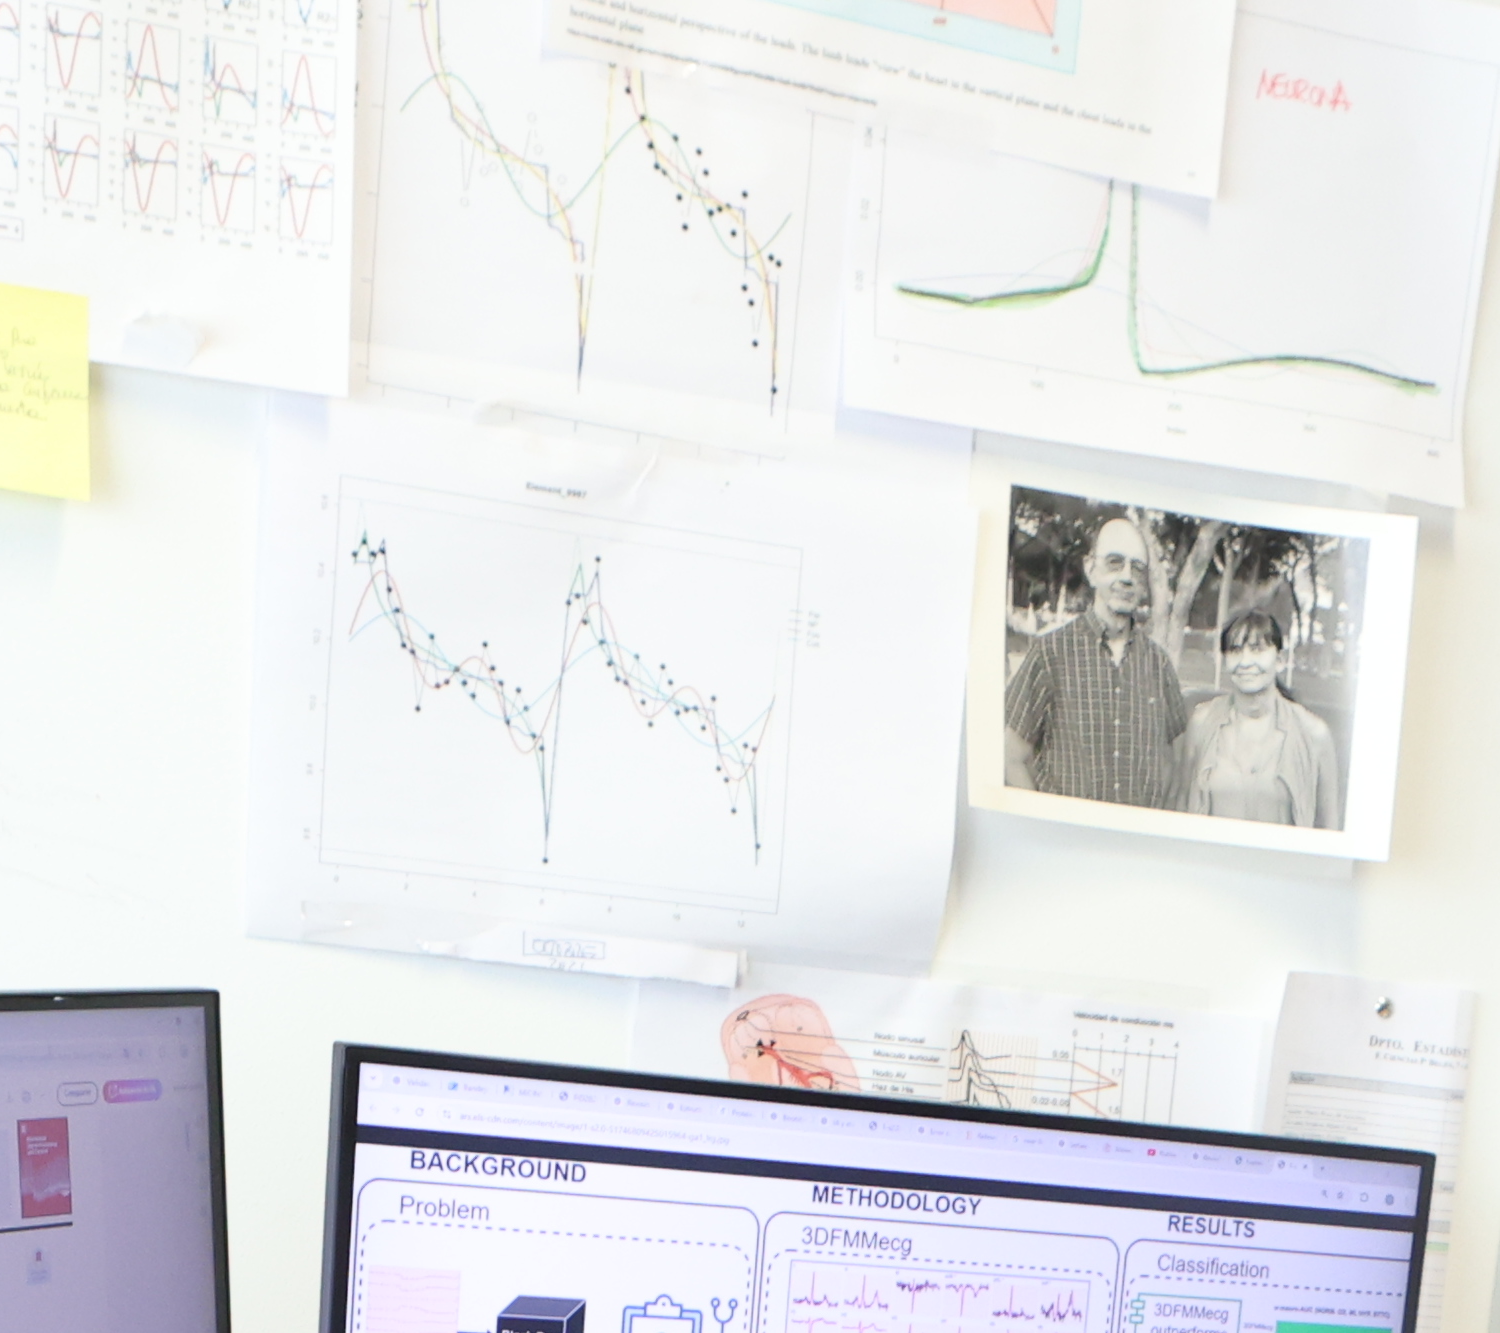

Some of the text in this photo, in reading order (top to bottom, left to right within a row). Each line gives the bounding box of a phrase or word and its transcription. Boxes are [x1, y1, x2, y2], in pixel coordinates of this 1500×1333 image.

[410, 1150, 587, 1183] BACKGROUND
[400, 1195, 490, 1222] Problem
[811, 1184, 982, 1216] METHODOLOGY
[1167, 1214, 1256, 1239] RESULTS
[801, 1226, 913, 1257] 3DFMMecg
[1157, 1253, 1270, 1279] Classification
[1154, 1303, 1229, 1324] 3DFMMecg
